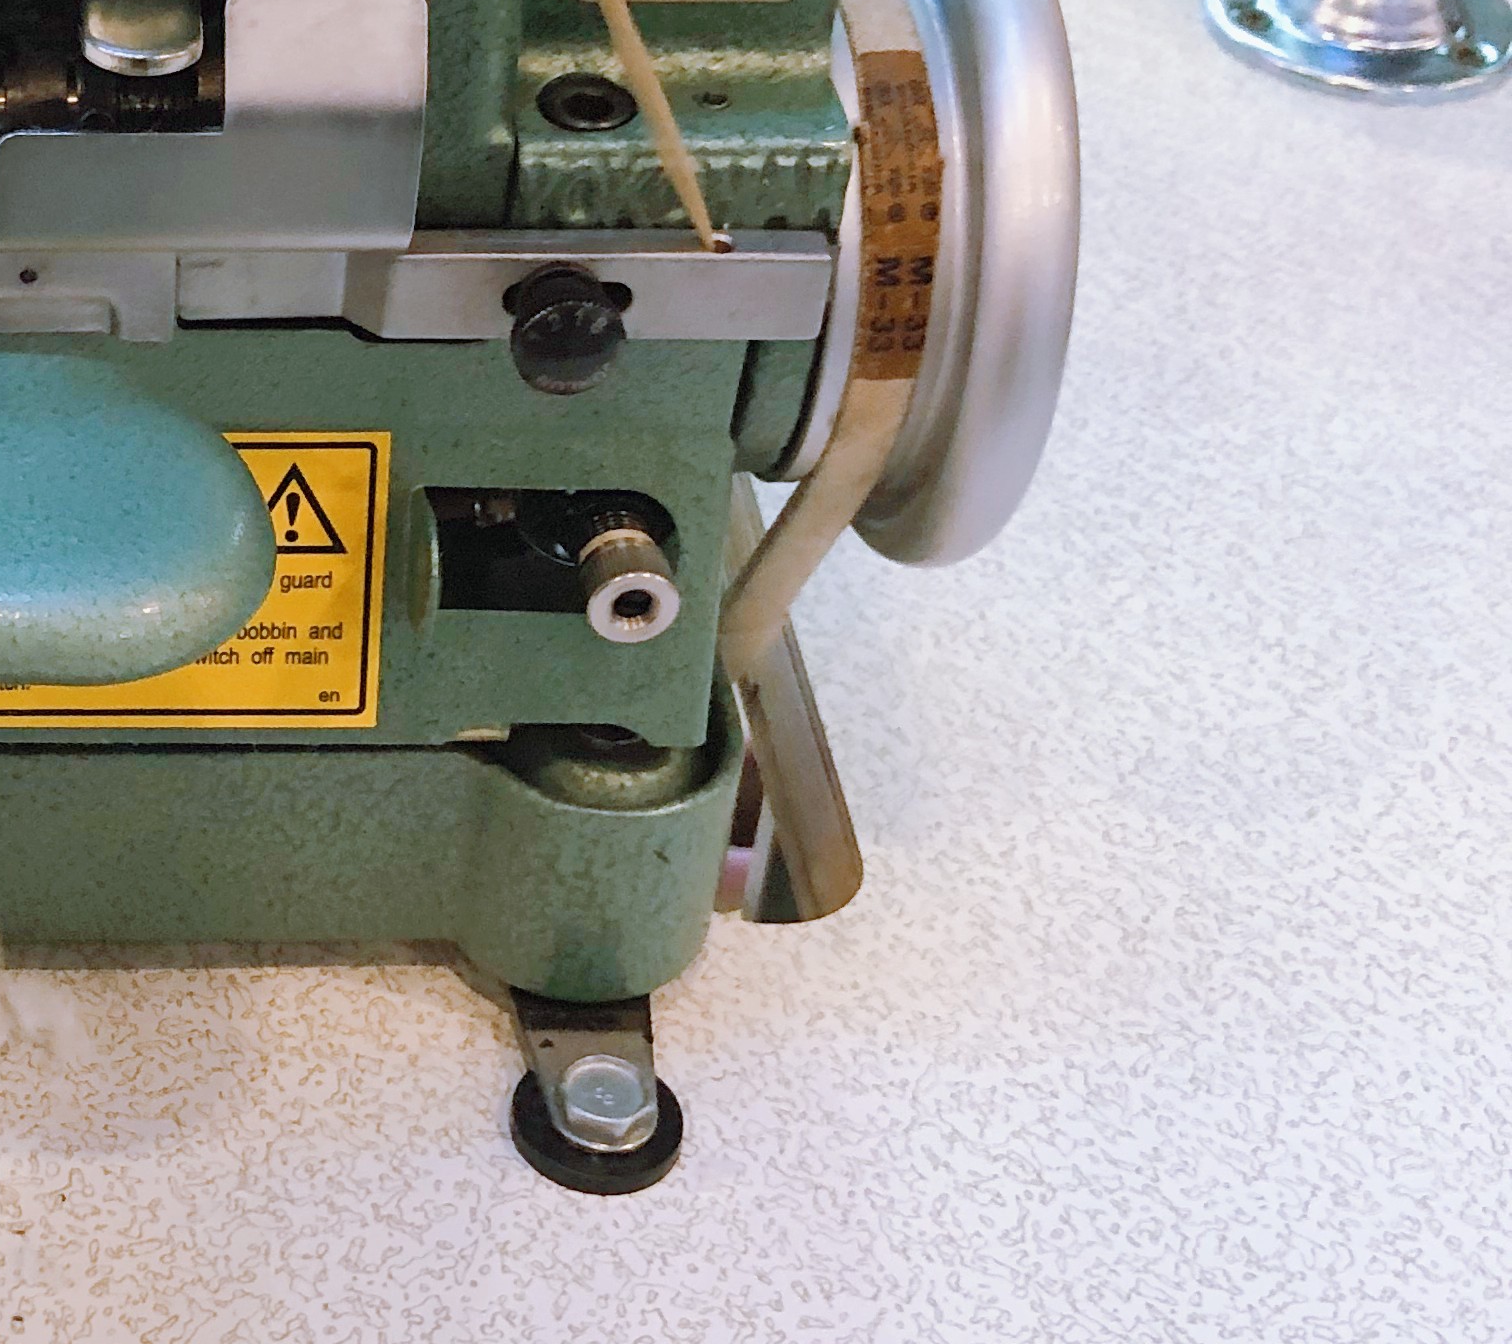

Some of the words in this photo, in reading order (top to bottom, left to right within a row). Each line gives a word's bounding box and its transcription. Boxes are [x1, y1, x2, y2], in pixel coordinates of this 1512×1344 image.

[280, 571, 333, 593] guard
[309, 622, 343, 640] and
[194, 647, 239, 665] witch
[251, 647, 275, 665] off
[285, 647, 329, 665] main
[318, 689, 341, 703] en
